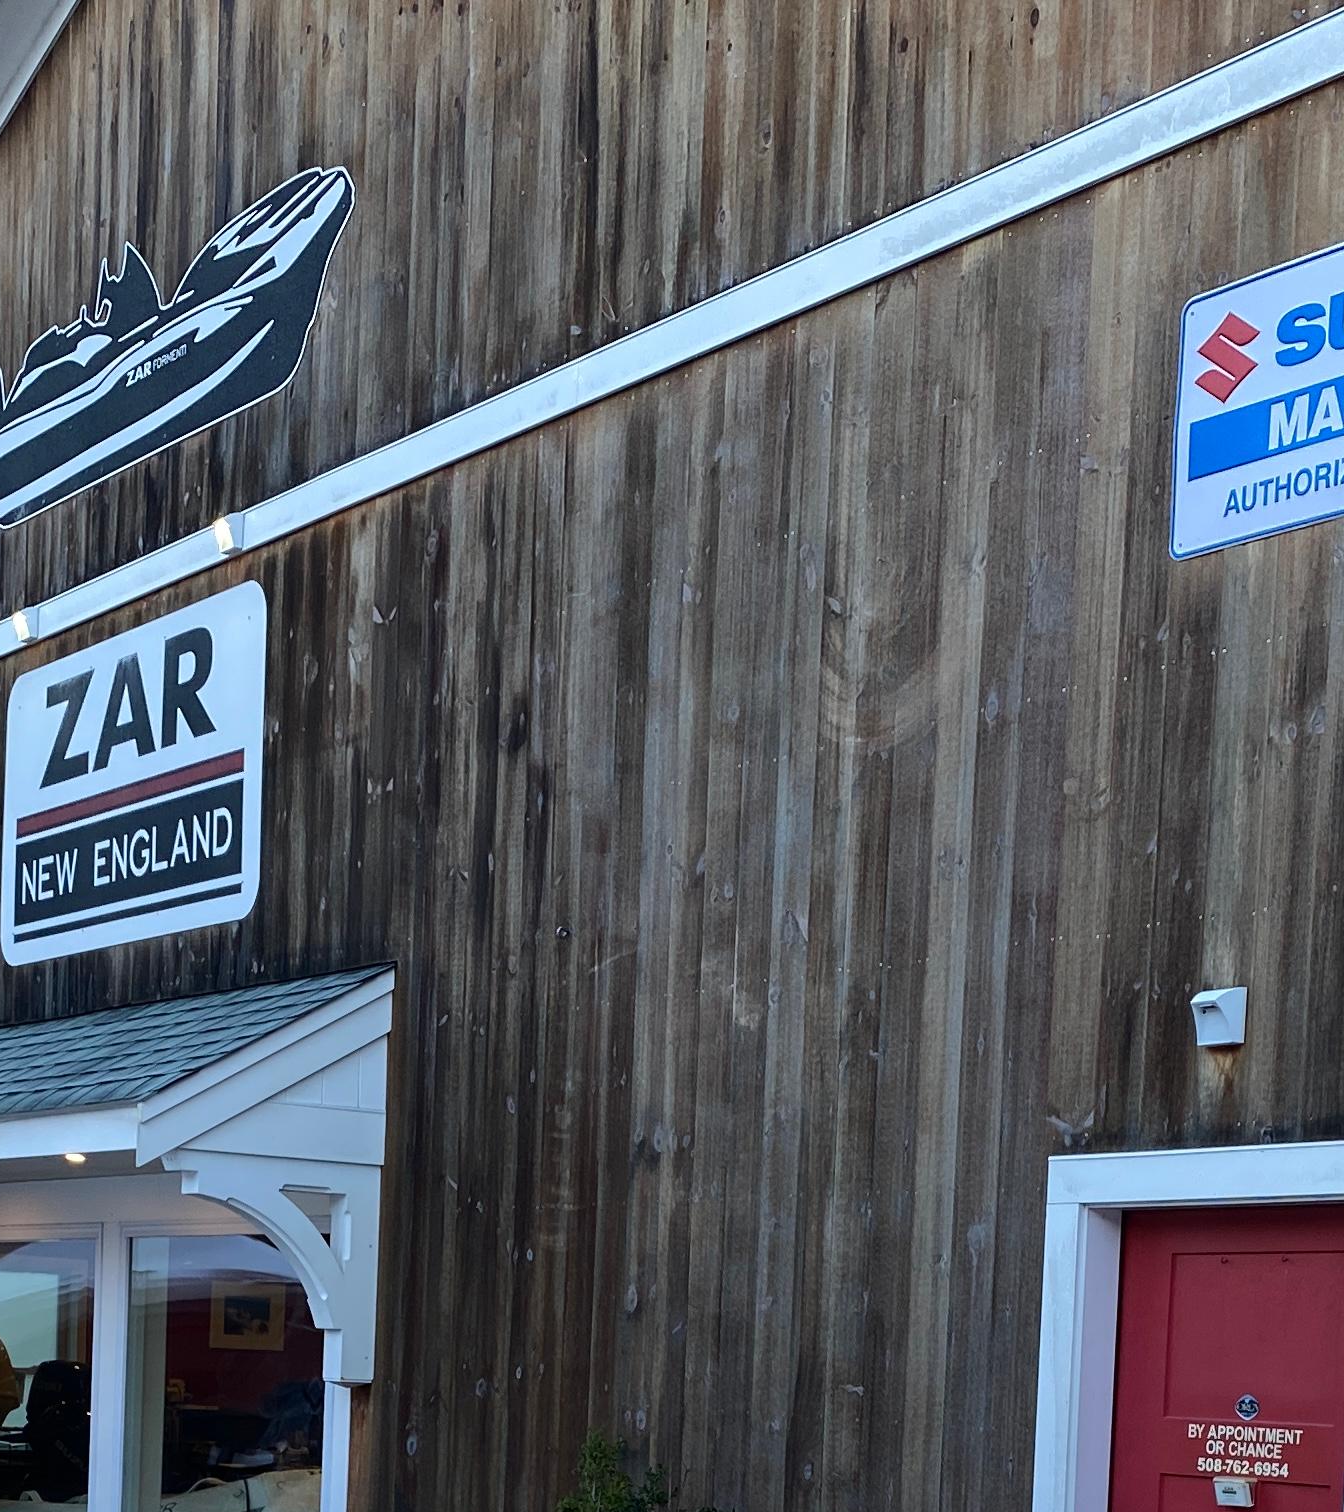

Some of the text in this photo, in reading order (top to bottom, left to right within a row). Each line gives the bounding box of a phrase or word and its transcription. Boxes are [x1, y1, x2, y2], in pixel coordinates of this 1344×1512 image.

[126, 360, 152, 388] ZAR
[39, 626, 217, 790] ZAR
[21, 806, 234, 905] NEW ENGLAND
[1188, 1423, 1304, 1445] BY APPOINTMENT
[1206, 1440, 1283, 1459] OR CHANCE
[1197, 1457, 1289, 1478] 508-762-6954
